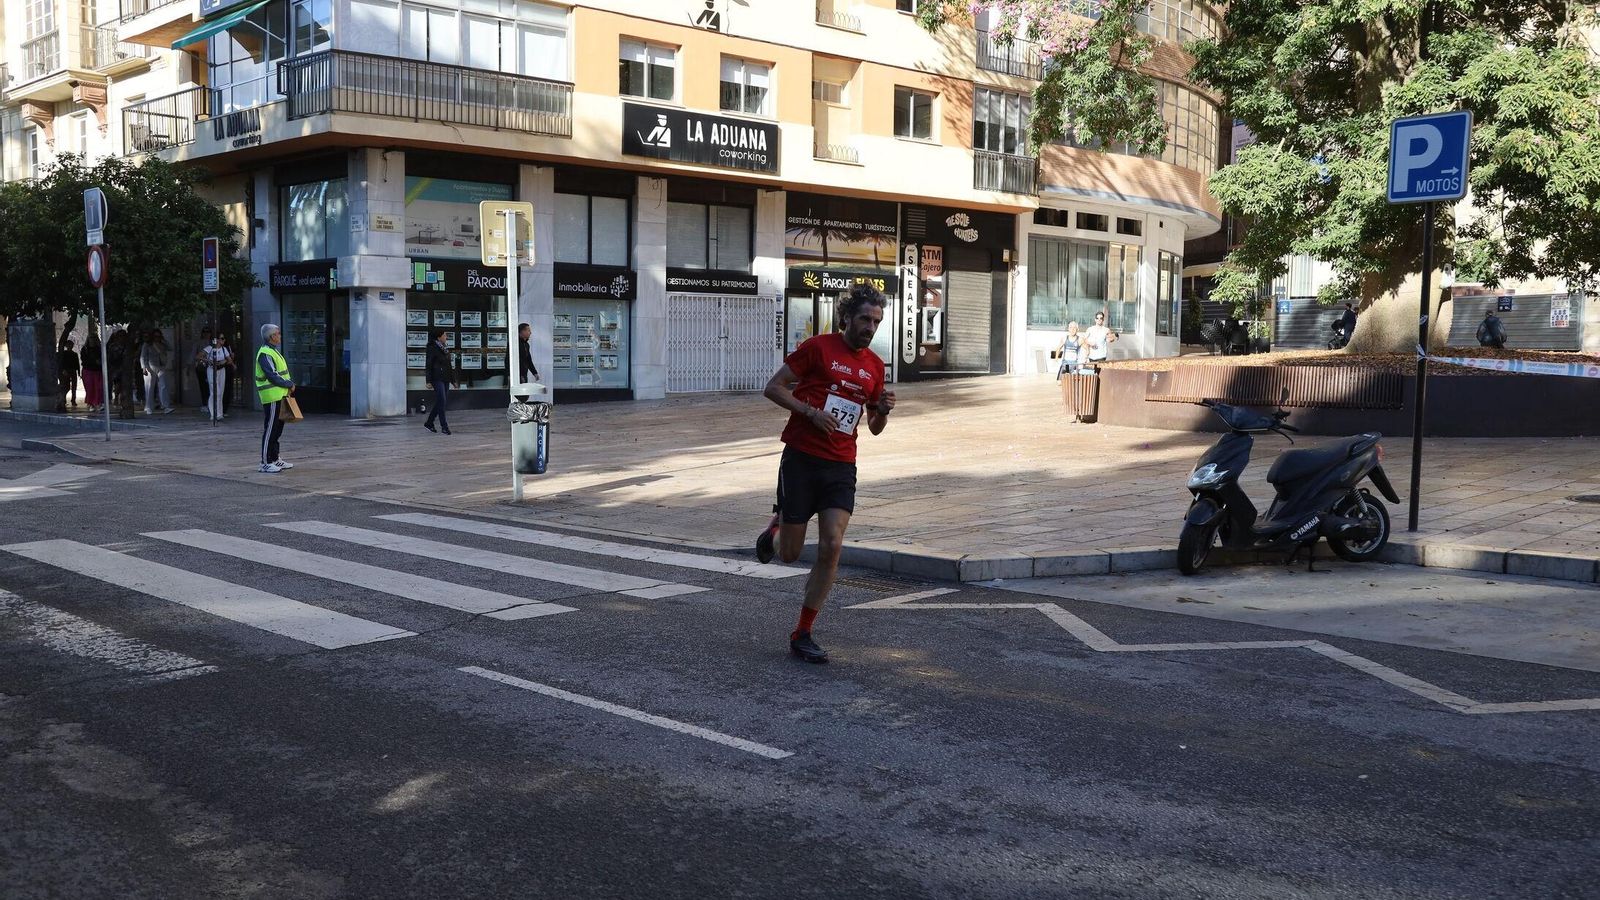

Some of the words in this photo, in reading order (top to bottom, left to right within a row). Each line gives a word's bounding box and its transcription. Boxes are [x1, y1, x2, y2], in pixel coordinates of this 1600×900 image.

[214, 118, 224, 141] LA
[687, 119, 704, 143] LA
[710, 123, 767, 151] ADUANA
[233, 134, 262, 148] coworking
[719, 149, 767, 165] coworking
[1393, 124, 1443, 193] P
[1416, 177, 1460, 193] MOTOS
[788, 216, 812, 225] GESTIÓN
[813, 218, 821, 226] DE
[823, 220, 862, 230] APARTAMENTOS
[865, 223, 895, 233] TURÍSTICOS
[921, 248, 941, 260] ATM
[273, 275, 297, 288] PARQUE
[298, 274, 310, 286] real
[310, 275, 326, 286] estate
[467, 277, 508, 290] PARQU
[558, 281, 607, 293] inmobiliaria
[667, 277, 709, 287] GESTIONAMOS
[711, 279, 720, 287] SU
[721, 280, 756, 289] PATRIMONIO
[831, 407, 855, 425] 573
[1297, 516, 1320, 535] YAMAHA
